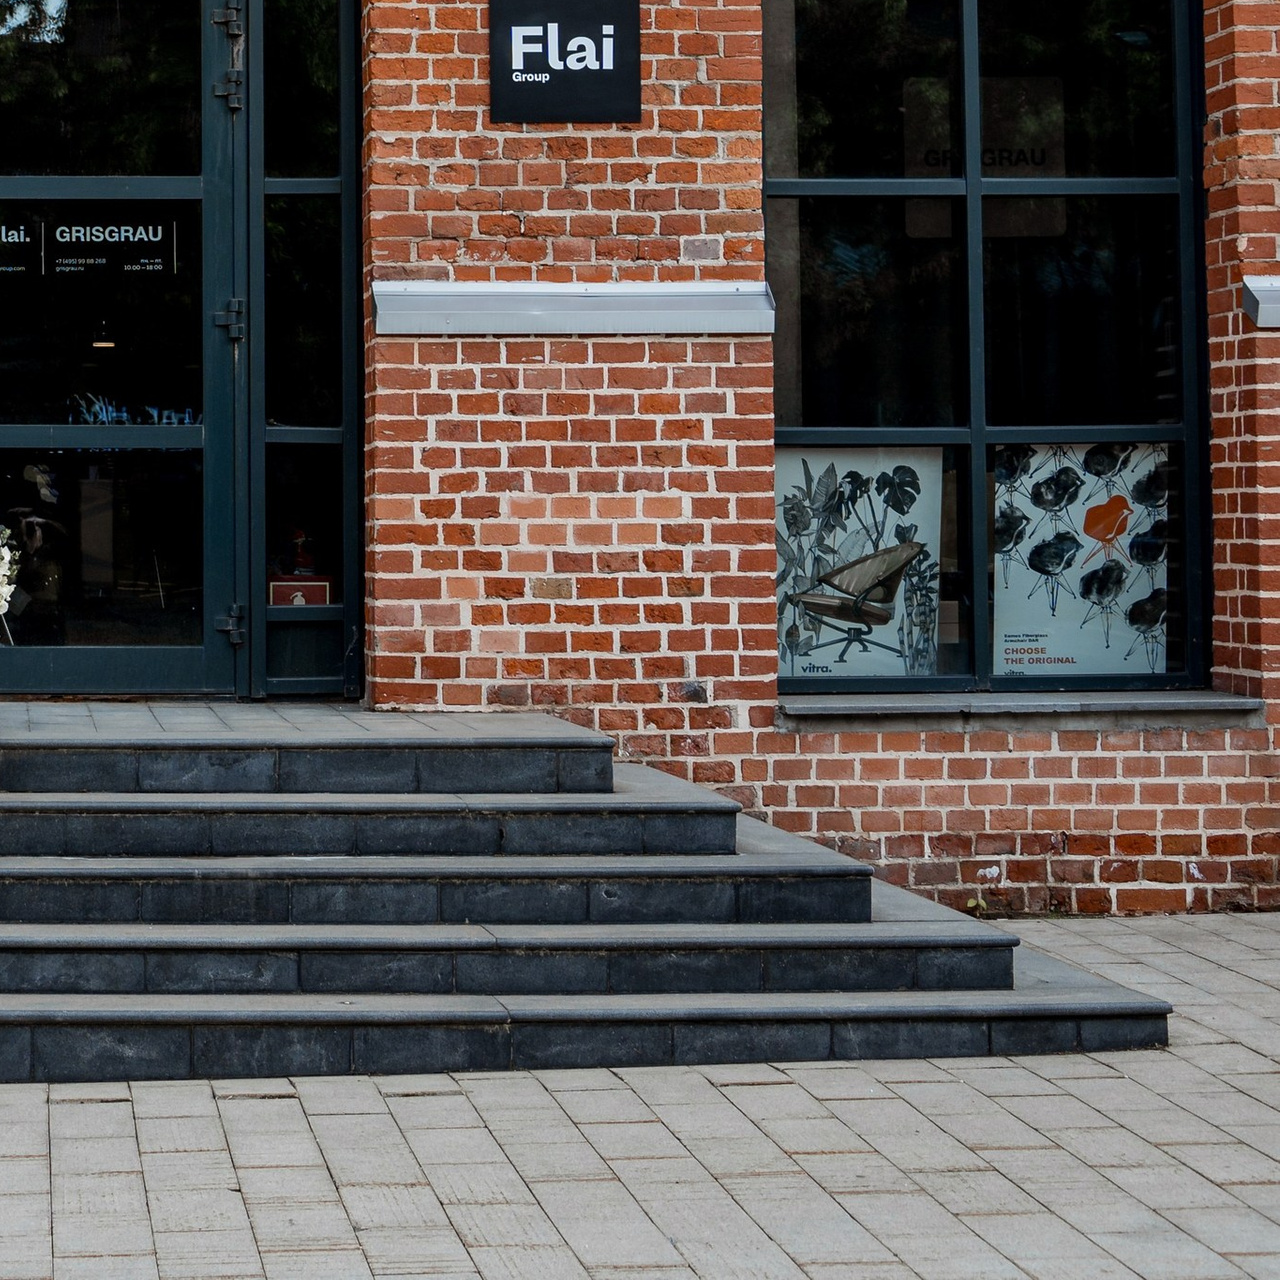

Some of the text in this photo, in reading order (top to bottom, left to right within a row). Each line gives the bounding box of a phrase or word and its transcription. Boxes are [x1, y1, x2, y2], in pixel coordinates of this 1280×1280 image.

[511, 22, 615, 71] Flai
[512, 71, 550, 83] Group
[55, 226, 163, 243] GRISGRAU
[1004, 647, 1047, 655] CHOOSE
[1004, 657, 1077, 665] THE ORIGINAL
[801, 662, 833, 673] vitra.
